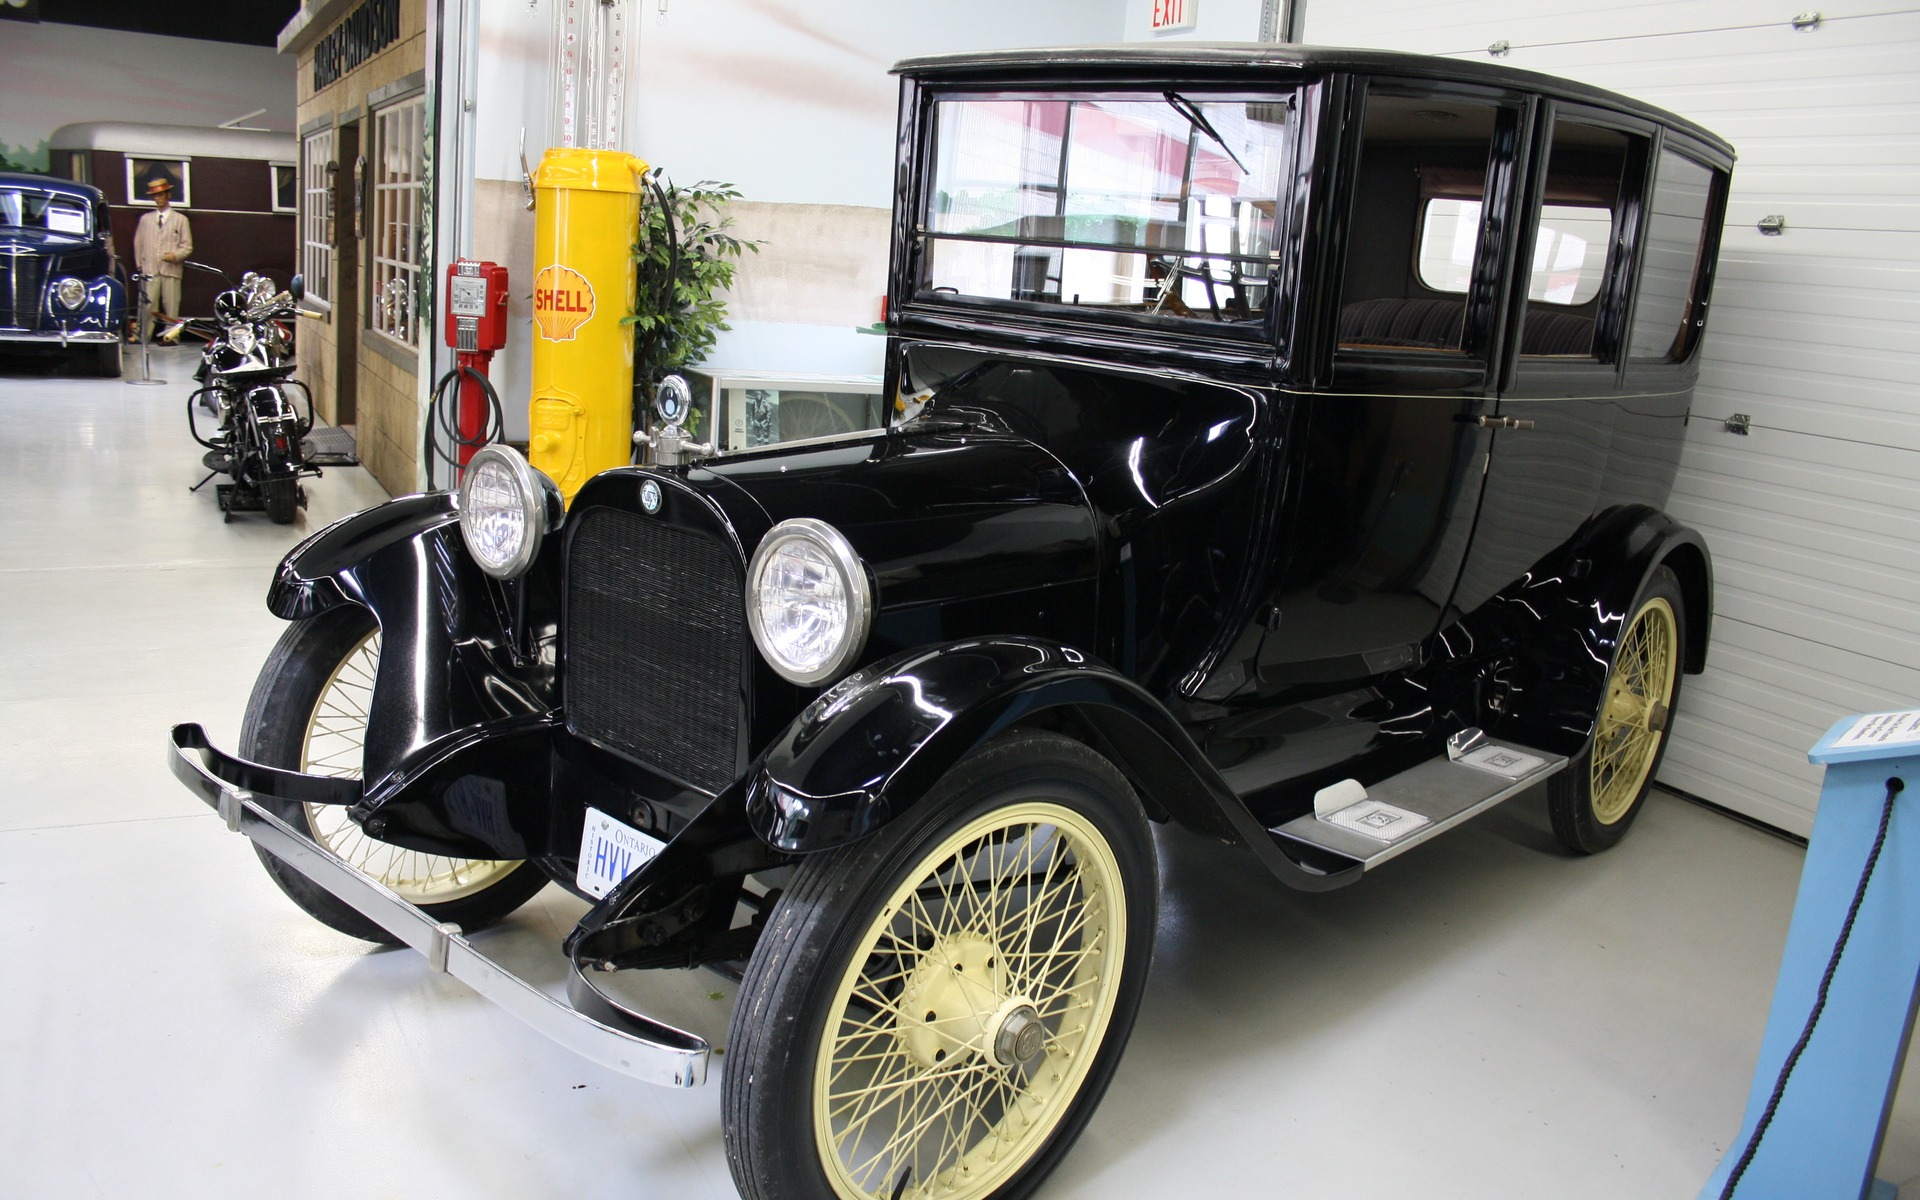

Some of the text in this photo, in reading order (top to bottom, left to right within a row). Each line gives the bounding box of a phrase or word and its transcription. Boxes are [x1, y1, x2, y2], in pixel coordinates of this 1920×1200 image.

[568, 0, 574, 8] 2
[567, 17, 574, 25] 3
[567, 34, 574, 42] 4
[567, 50, 573, 58] 5
[566, 67, 572, 75] 6
[564, 117, 570, 125] 9
[563, 134, 572, 142] 10
[536, 289, 588, 313] SHELL
[615, 829, 656, 859] ONTARIO
[585, 825, 597, 880] HISTORIC
